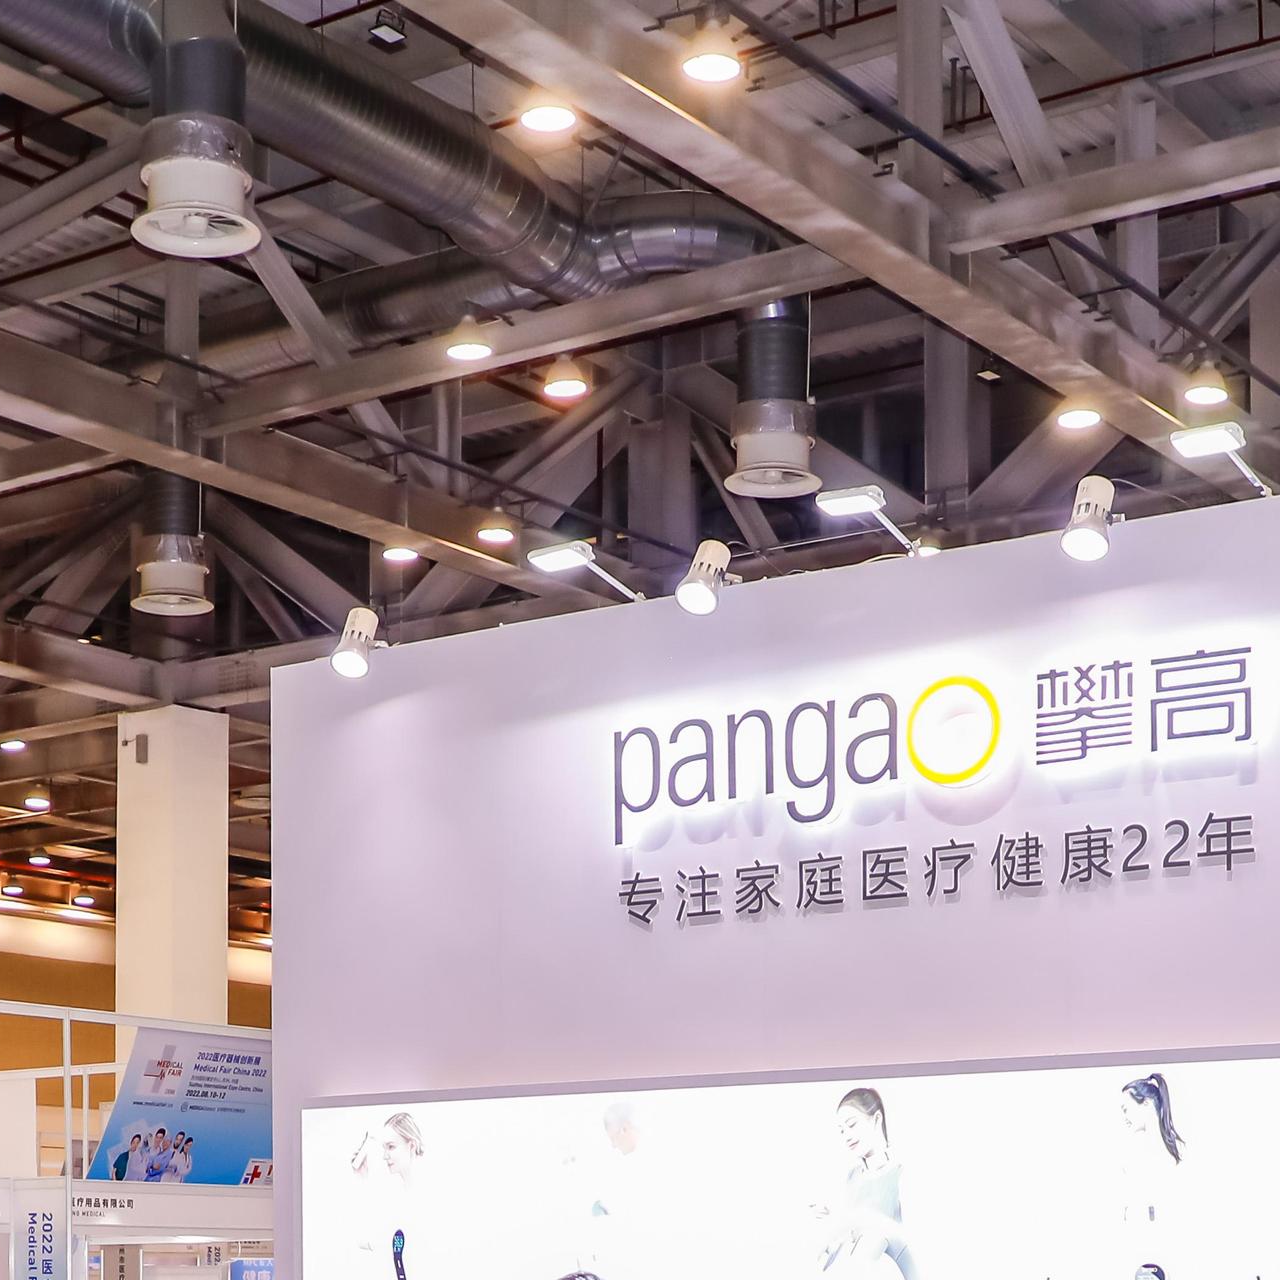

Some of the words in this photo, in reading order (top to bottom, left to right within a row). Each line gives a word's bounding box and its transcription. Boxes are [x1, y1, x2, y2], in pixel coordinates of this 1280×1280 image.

[1035, 646, 1251, 765] 攀高
[618, 810, 1255, 926] 专注家庭医疗健康22年
[156, 1059, 183, 1070] MEDICAL
[167, 1068, 182, 1077] FAIR
[193, 1063, 218, 1074] Medical
[219, 1065, 232, 1075] Fair
[233, 1066, 251, 1076] China
[252, 1068, 267, 1078] 2022
[28, 1213, 38, 1271] Medical
[42, 1213, 53, 1254] 2022
